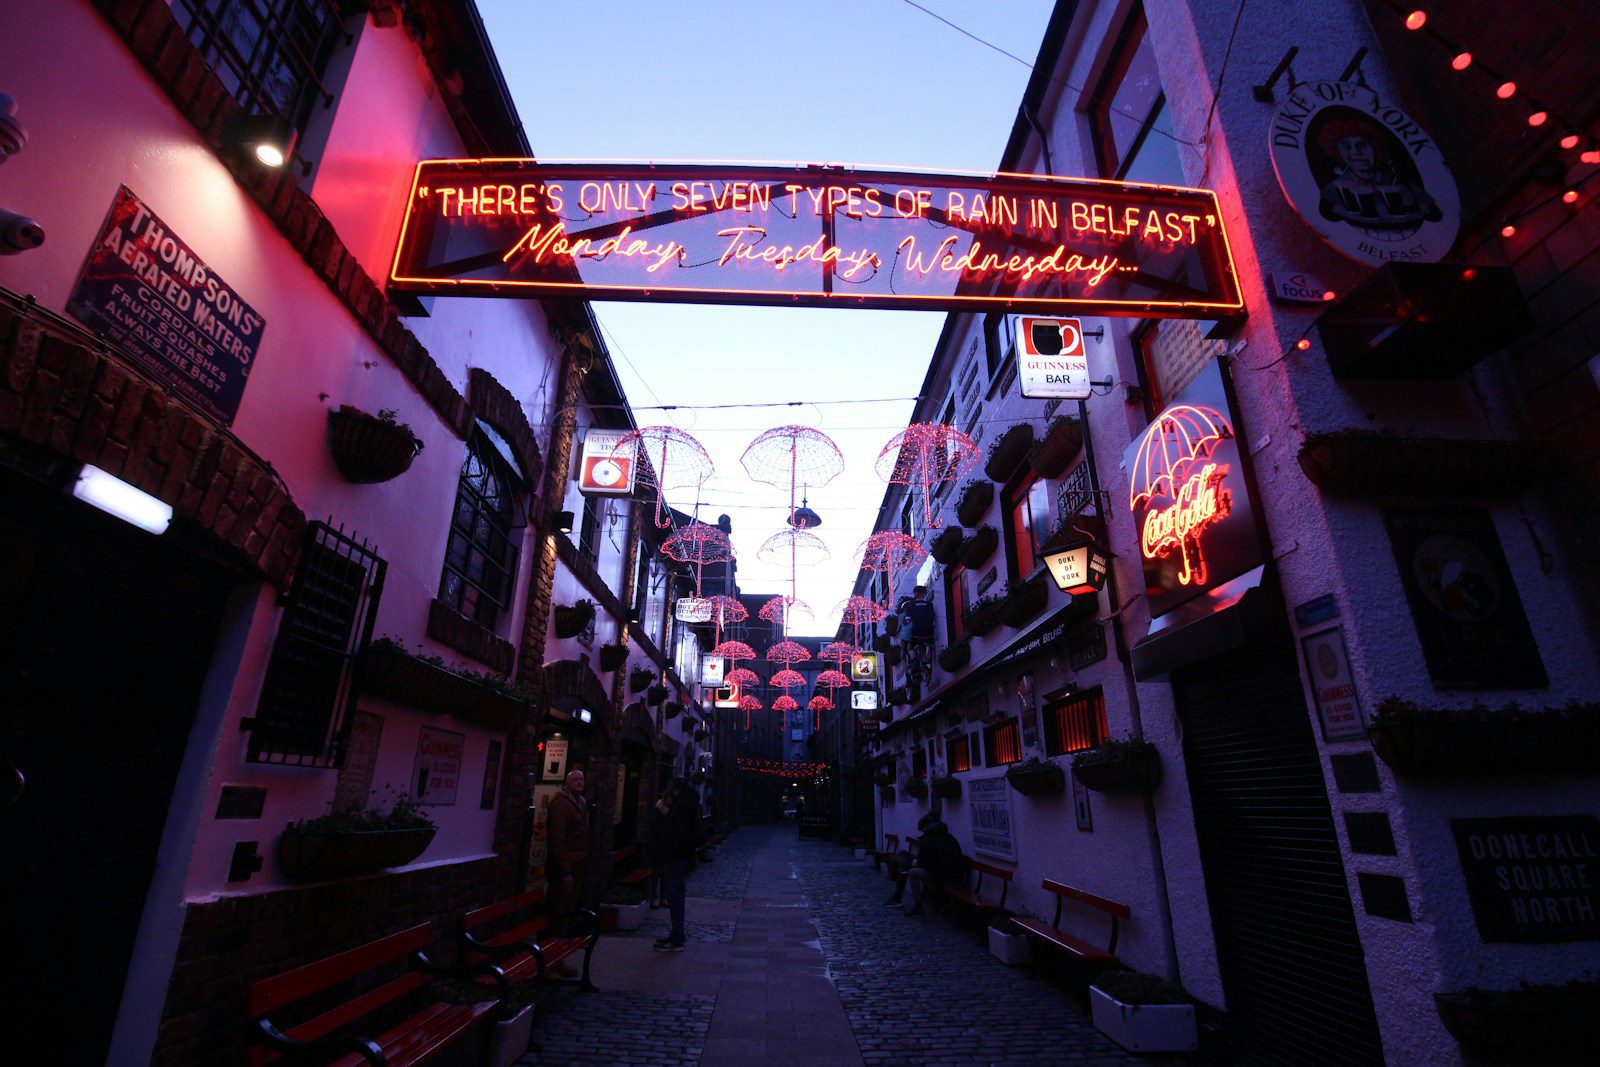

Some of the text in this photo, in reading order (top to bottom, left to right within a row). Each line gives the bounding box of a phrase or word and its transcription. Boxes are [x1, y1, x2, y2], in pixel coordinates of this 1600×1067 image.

[1275, 82, 1437, 156] DUKE OF YORK
[580, 182, 655, 212] ONLY
[672, 182, 771, 213] SEVEN
[785, 185, 882, 217] TYPES
[895, 190, 932, 219] OF
[946, 191, 1017, 226] RAIN
[1031, 199, 1057, 229] IN
[1358, 242, 1429, 262] BELFAST
[103, 225, 253, 365] AERATED WATERS
[110, 283, 227, 383] FRUIT SQUASHES
[137, 286, 216, 357] CORDIALS
[104, 299, 222, 394] ALWAYS THE BEST
[1028, 361, 1087, 372] GUINNESS
[1045, 375, 1071, 385] BAR
[1058, 556, 1076, 565] DUKE
[1064, 564, 1073, 572] OF
[1061, 572, 1080, 581] YORK
[421, 733, 462, 760] GUINNESS
[1468, 832, 1600, 860] DONEGALL
[1494, 864, 1592, 891] SQUARE
[1511, 896, 1600, 923] NORTH
